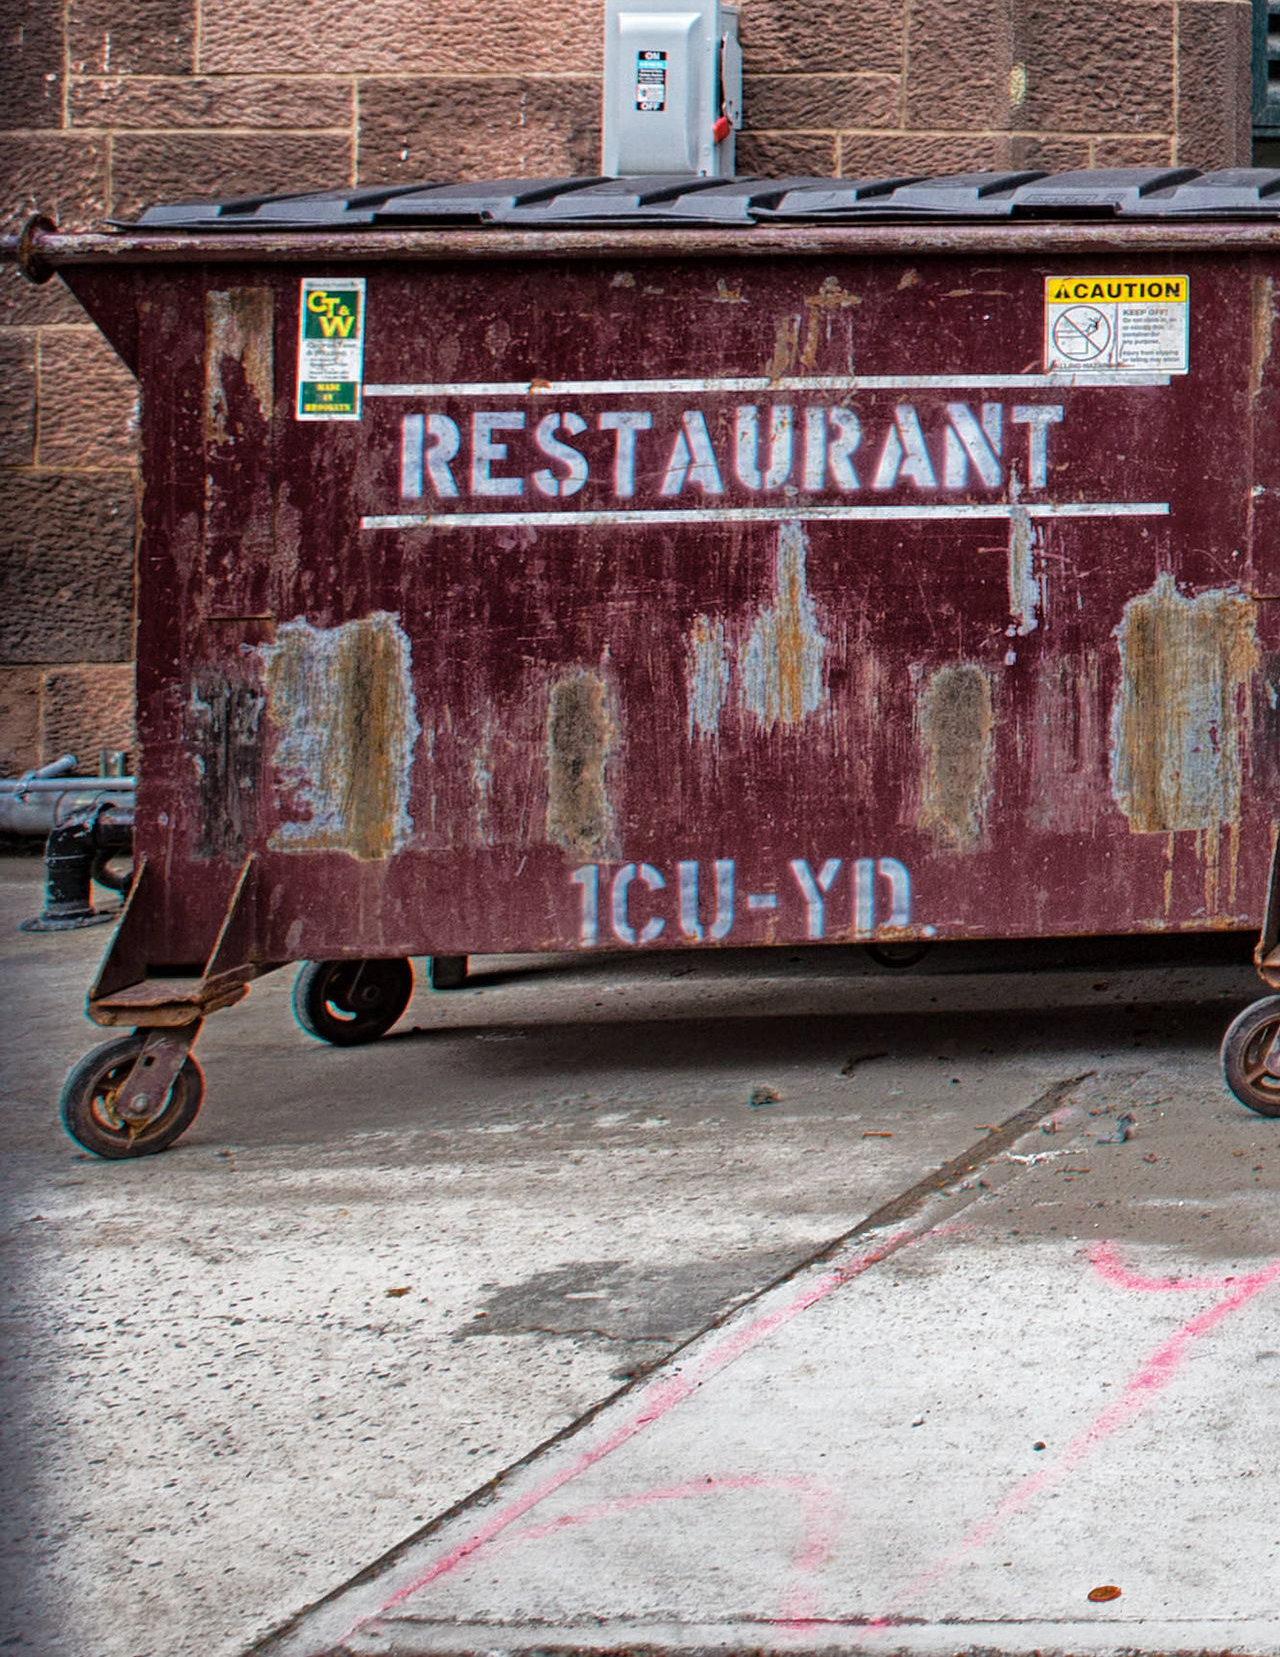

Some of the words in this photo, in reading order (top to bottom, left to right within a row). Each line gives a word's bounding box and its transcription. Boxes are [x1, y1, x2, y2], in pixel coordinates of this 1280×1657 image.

[644, 51, 661, 60] ON
[640, 102, 661, 111] OFF
[1073, 282, 1181, 299] CAUTION
[401, 403, 1065, 499] RESTAURANT
